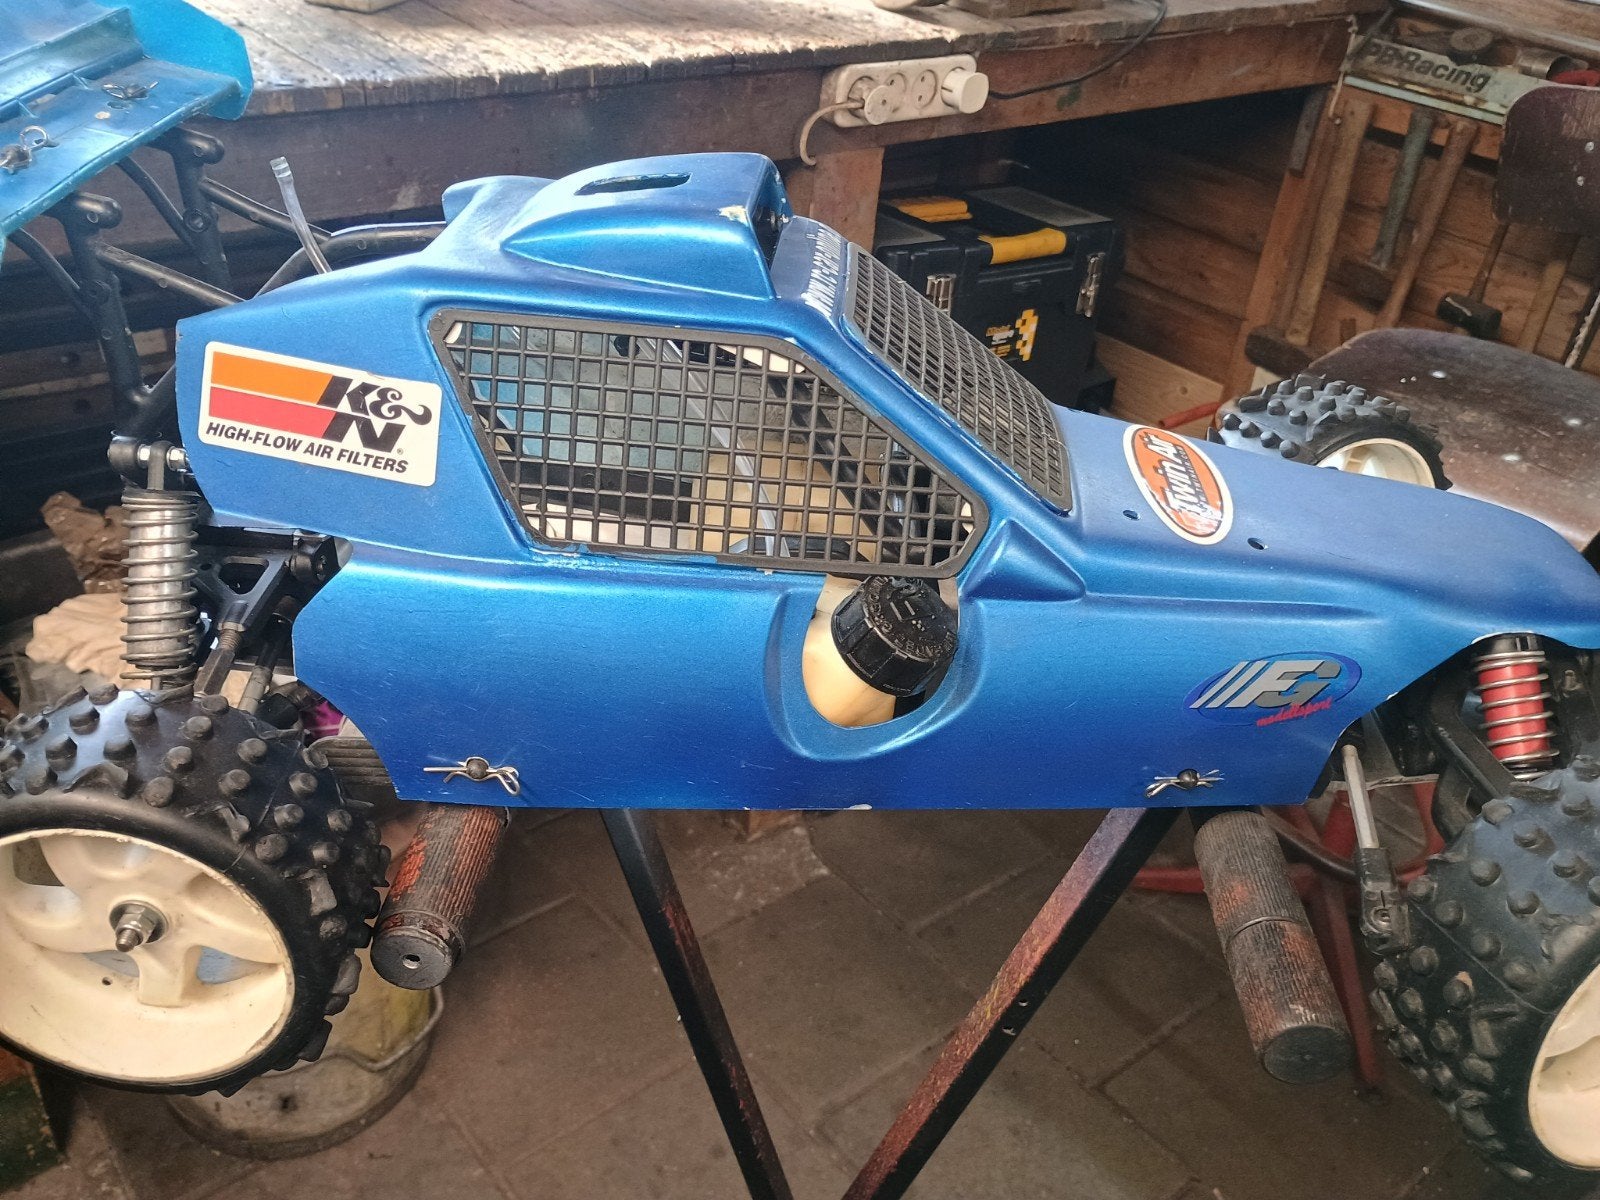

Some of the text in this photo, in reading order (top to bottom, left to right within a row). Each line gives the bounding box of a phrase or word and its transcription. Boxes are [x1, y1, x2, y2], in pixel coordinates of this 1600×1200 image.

[206, 422, 409, 473] HIGH-FLOW AIR FILTERS
